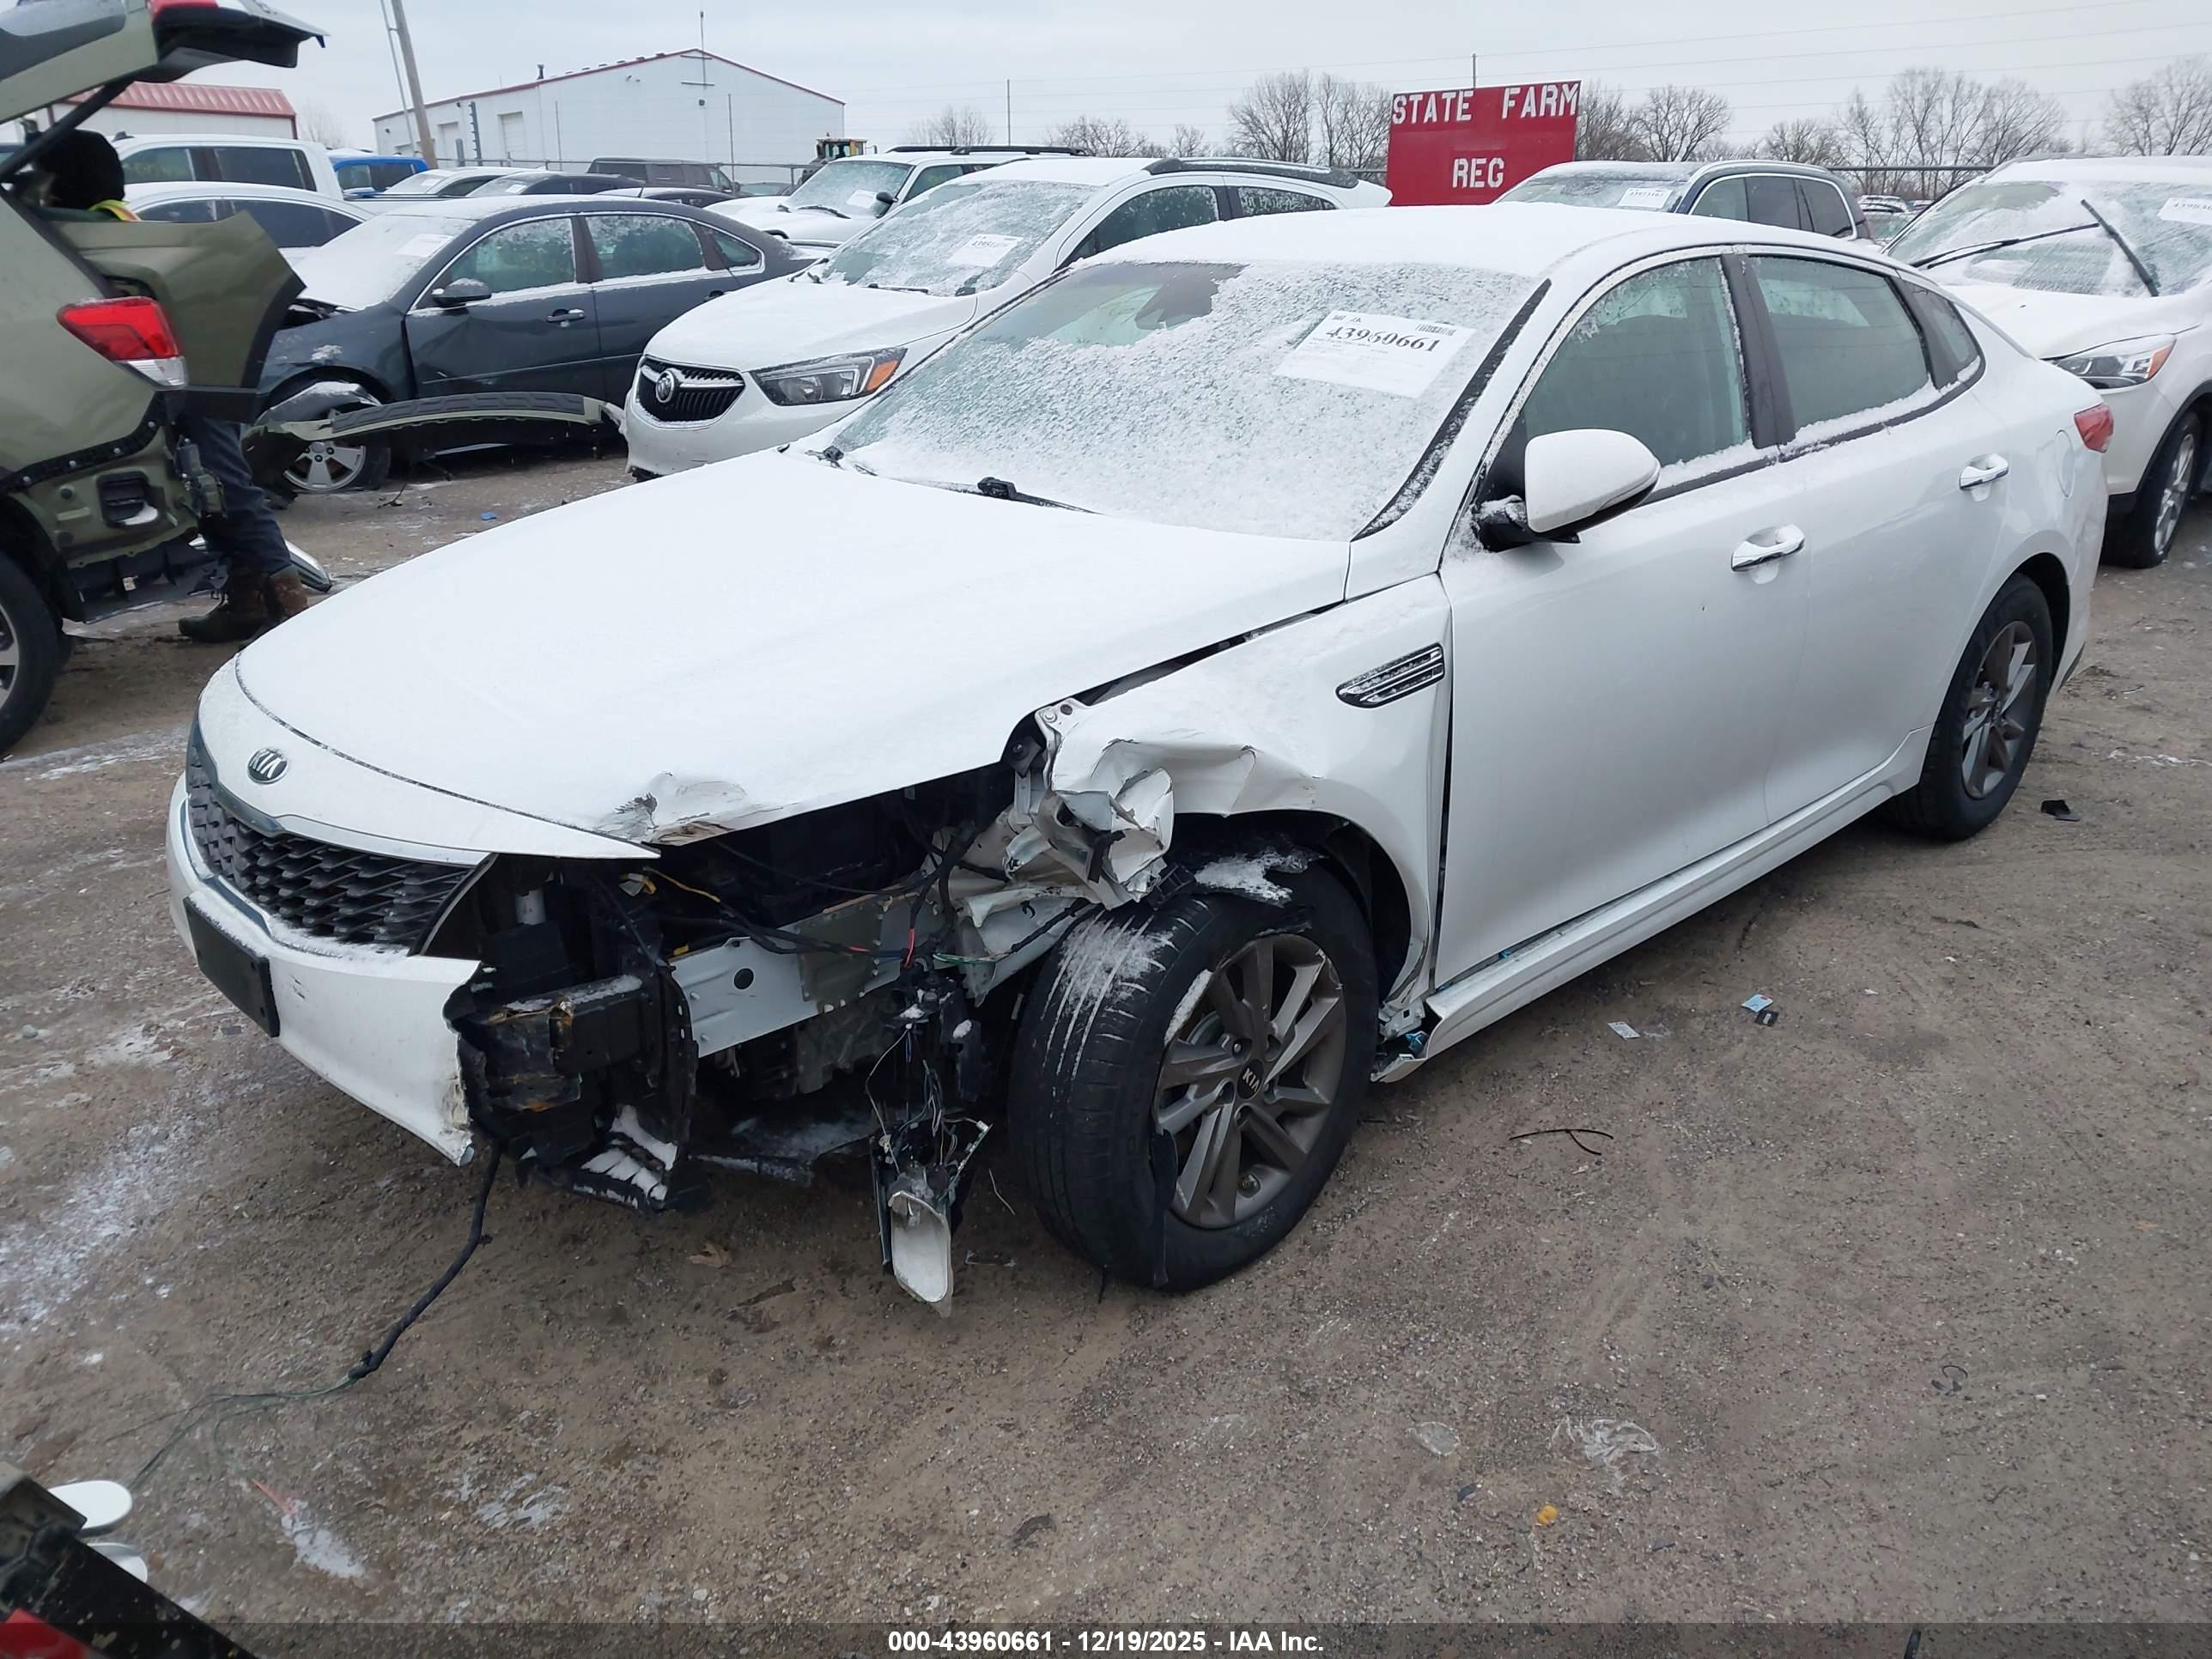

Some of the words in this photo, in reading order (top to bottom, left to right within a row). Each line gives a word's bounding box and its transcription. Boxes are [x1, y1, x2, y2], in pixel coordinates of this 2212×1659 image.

[1392, 90, 1474, 125] STATE
[1502, 83, 1579, 119] FARM
[1452, 157, 1505, 189] REG
[1242, 1067, 1260, 1092] KIA
